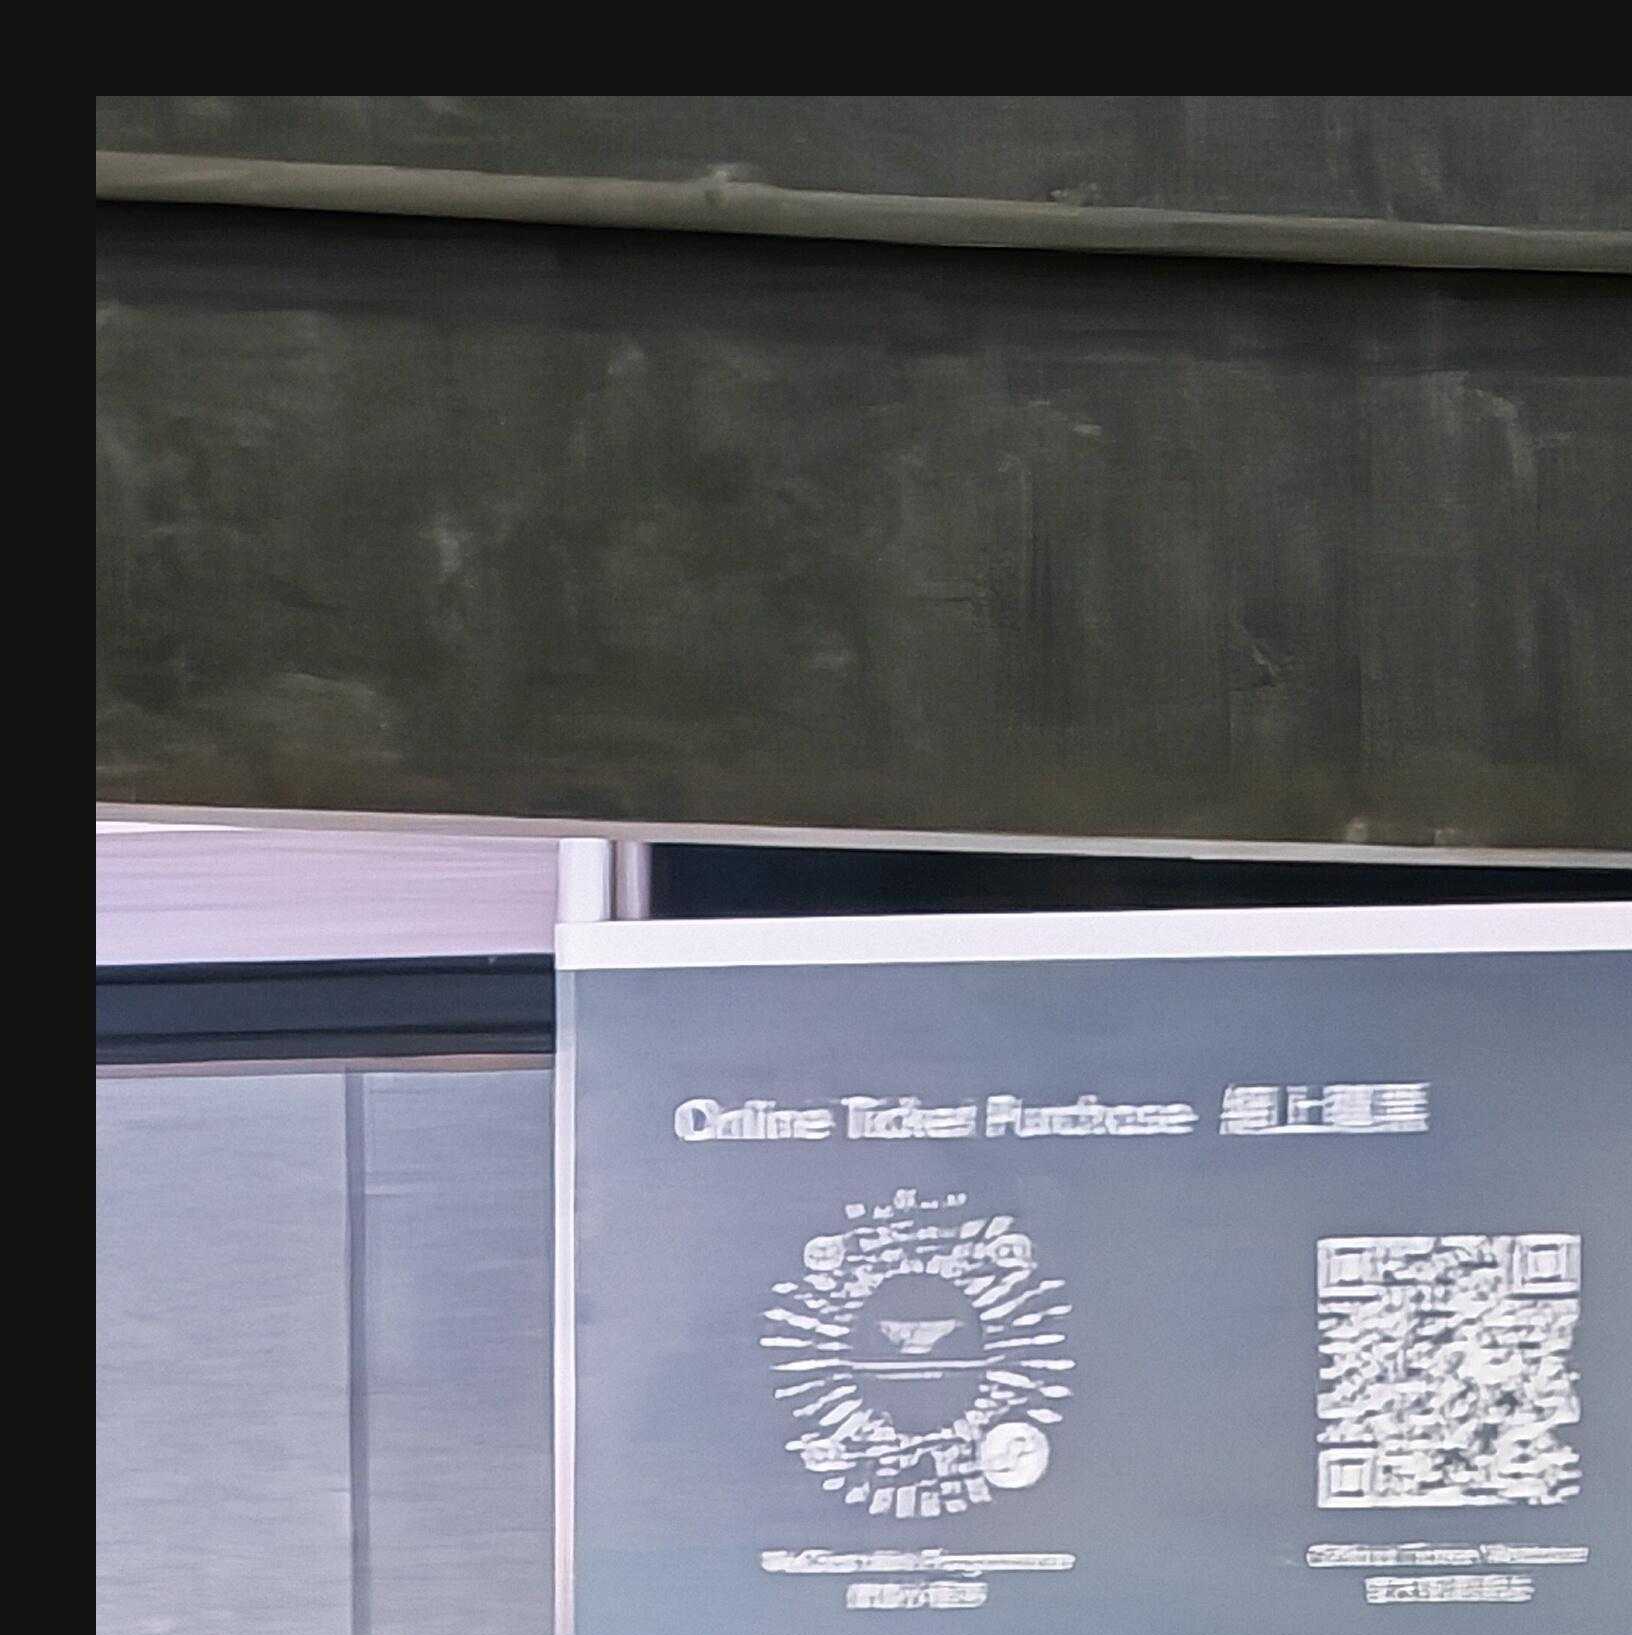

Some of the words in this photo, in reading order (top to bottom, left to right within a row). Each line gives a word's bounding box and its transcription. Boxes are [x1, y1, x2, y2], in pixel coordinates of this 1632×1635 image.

[674, 1098, 832, 1140] Online
[840, 1096, 976, 1140] Ticket
[985, 1095, 1199, 1138] Purchase
